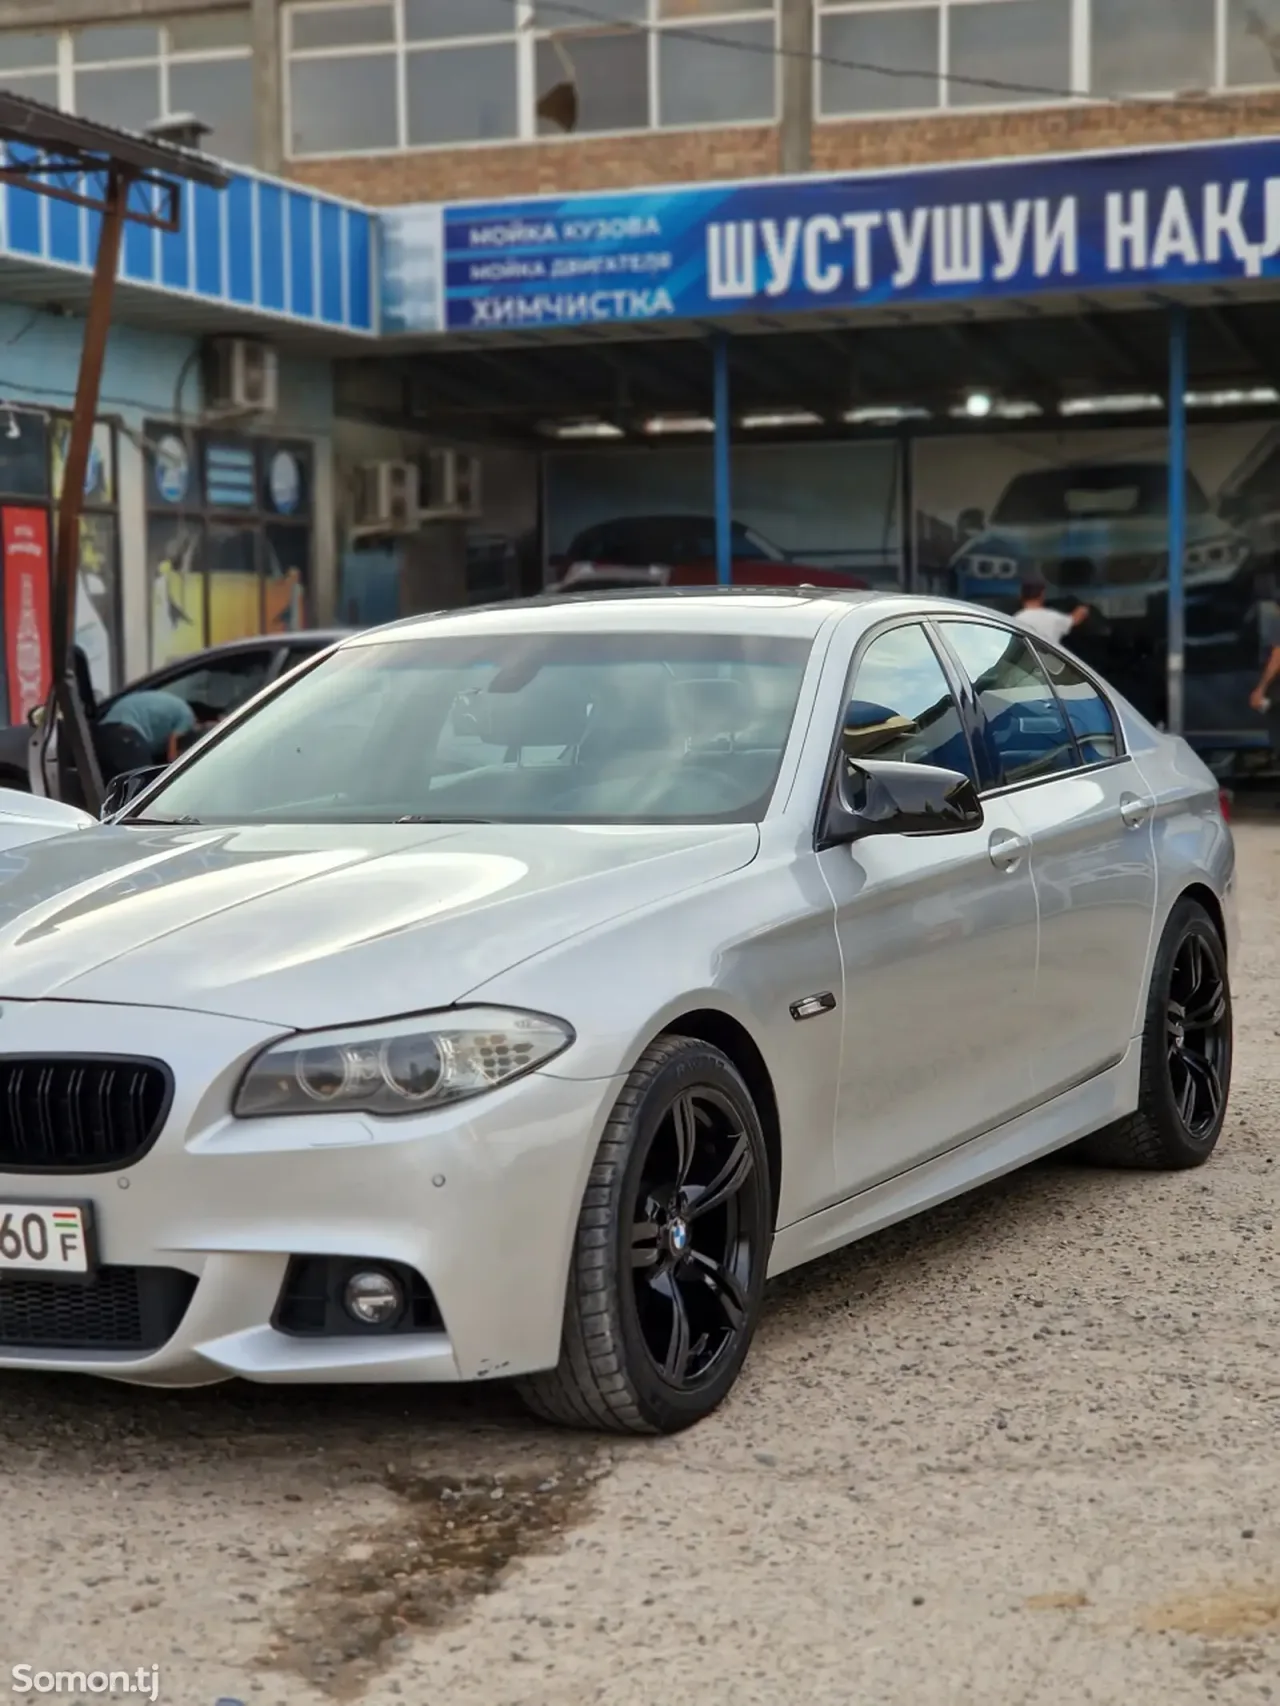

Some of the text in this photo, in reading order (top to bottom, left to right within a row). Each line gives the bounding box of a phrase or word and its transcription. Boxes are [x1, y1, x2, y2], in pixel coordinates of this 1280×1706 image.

[469, 216, 661, 247] МОЙКА КУЗОВА
[707, 195, 1078, 299] ШУСТУШУИ
[469, 255, 546, 280] МОЙКА
[472, 287, 675, 326] ХИМЧИСТКА
[60, 1233, 77, 1261] F
